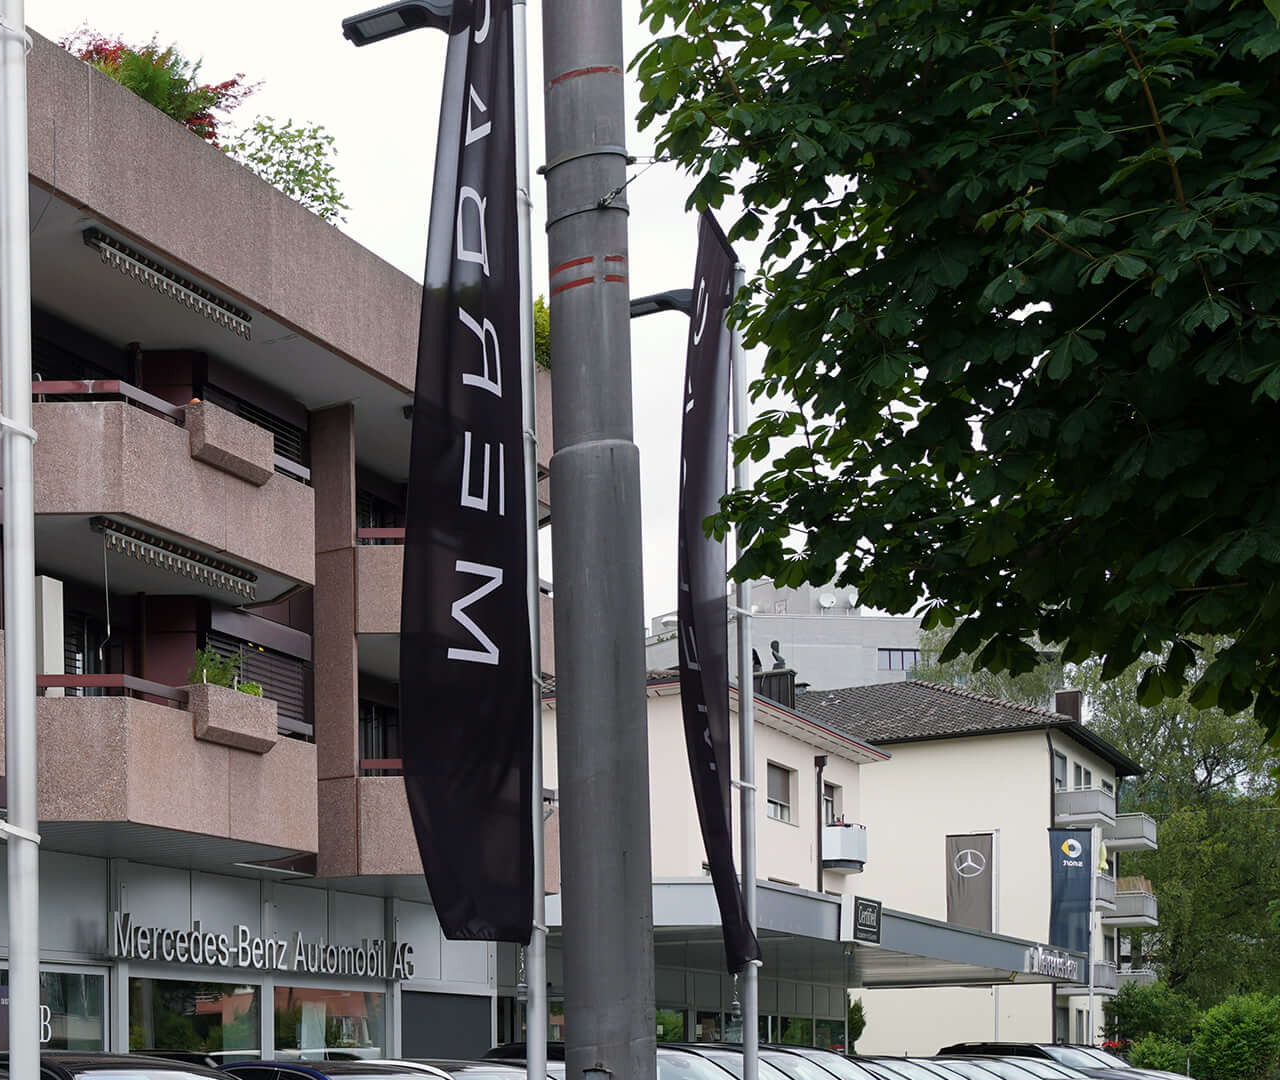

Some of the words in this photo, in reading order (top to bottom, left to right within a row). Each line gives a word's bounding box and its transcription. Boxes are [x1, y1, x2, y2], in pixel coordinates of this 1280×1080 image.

[114, 911, 288, 970] Mercedes-Benz
[294, 931, 387, 977] Automobil
[392, 942, 416, 980] AG
